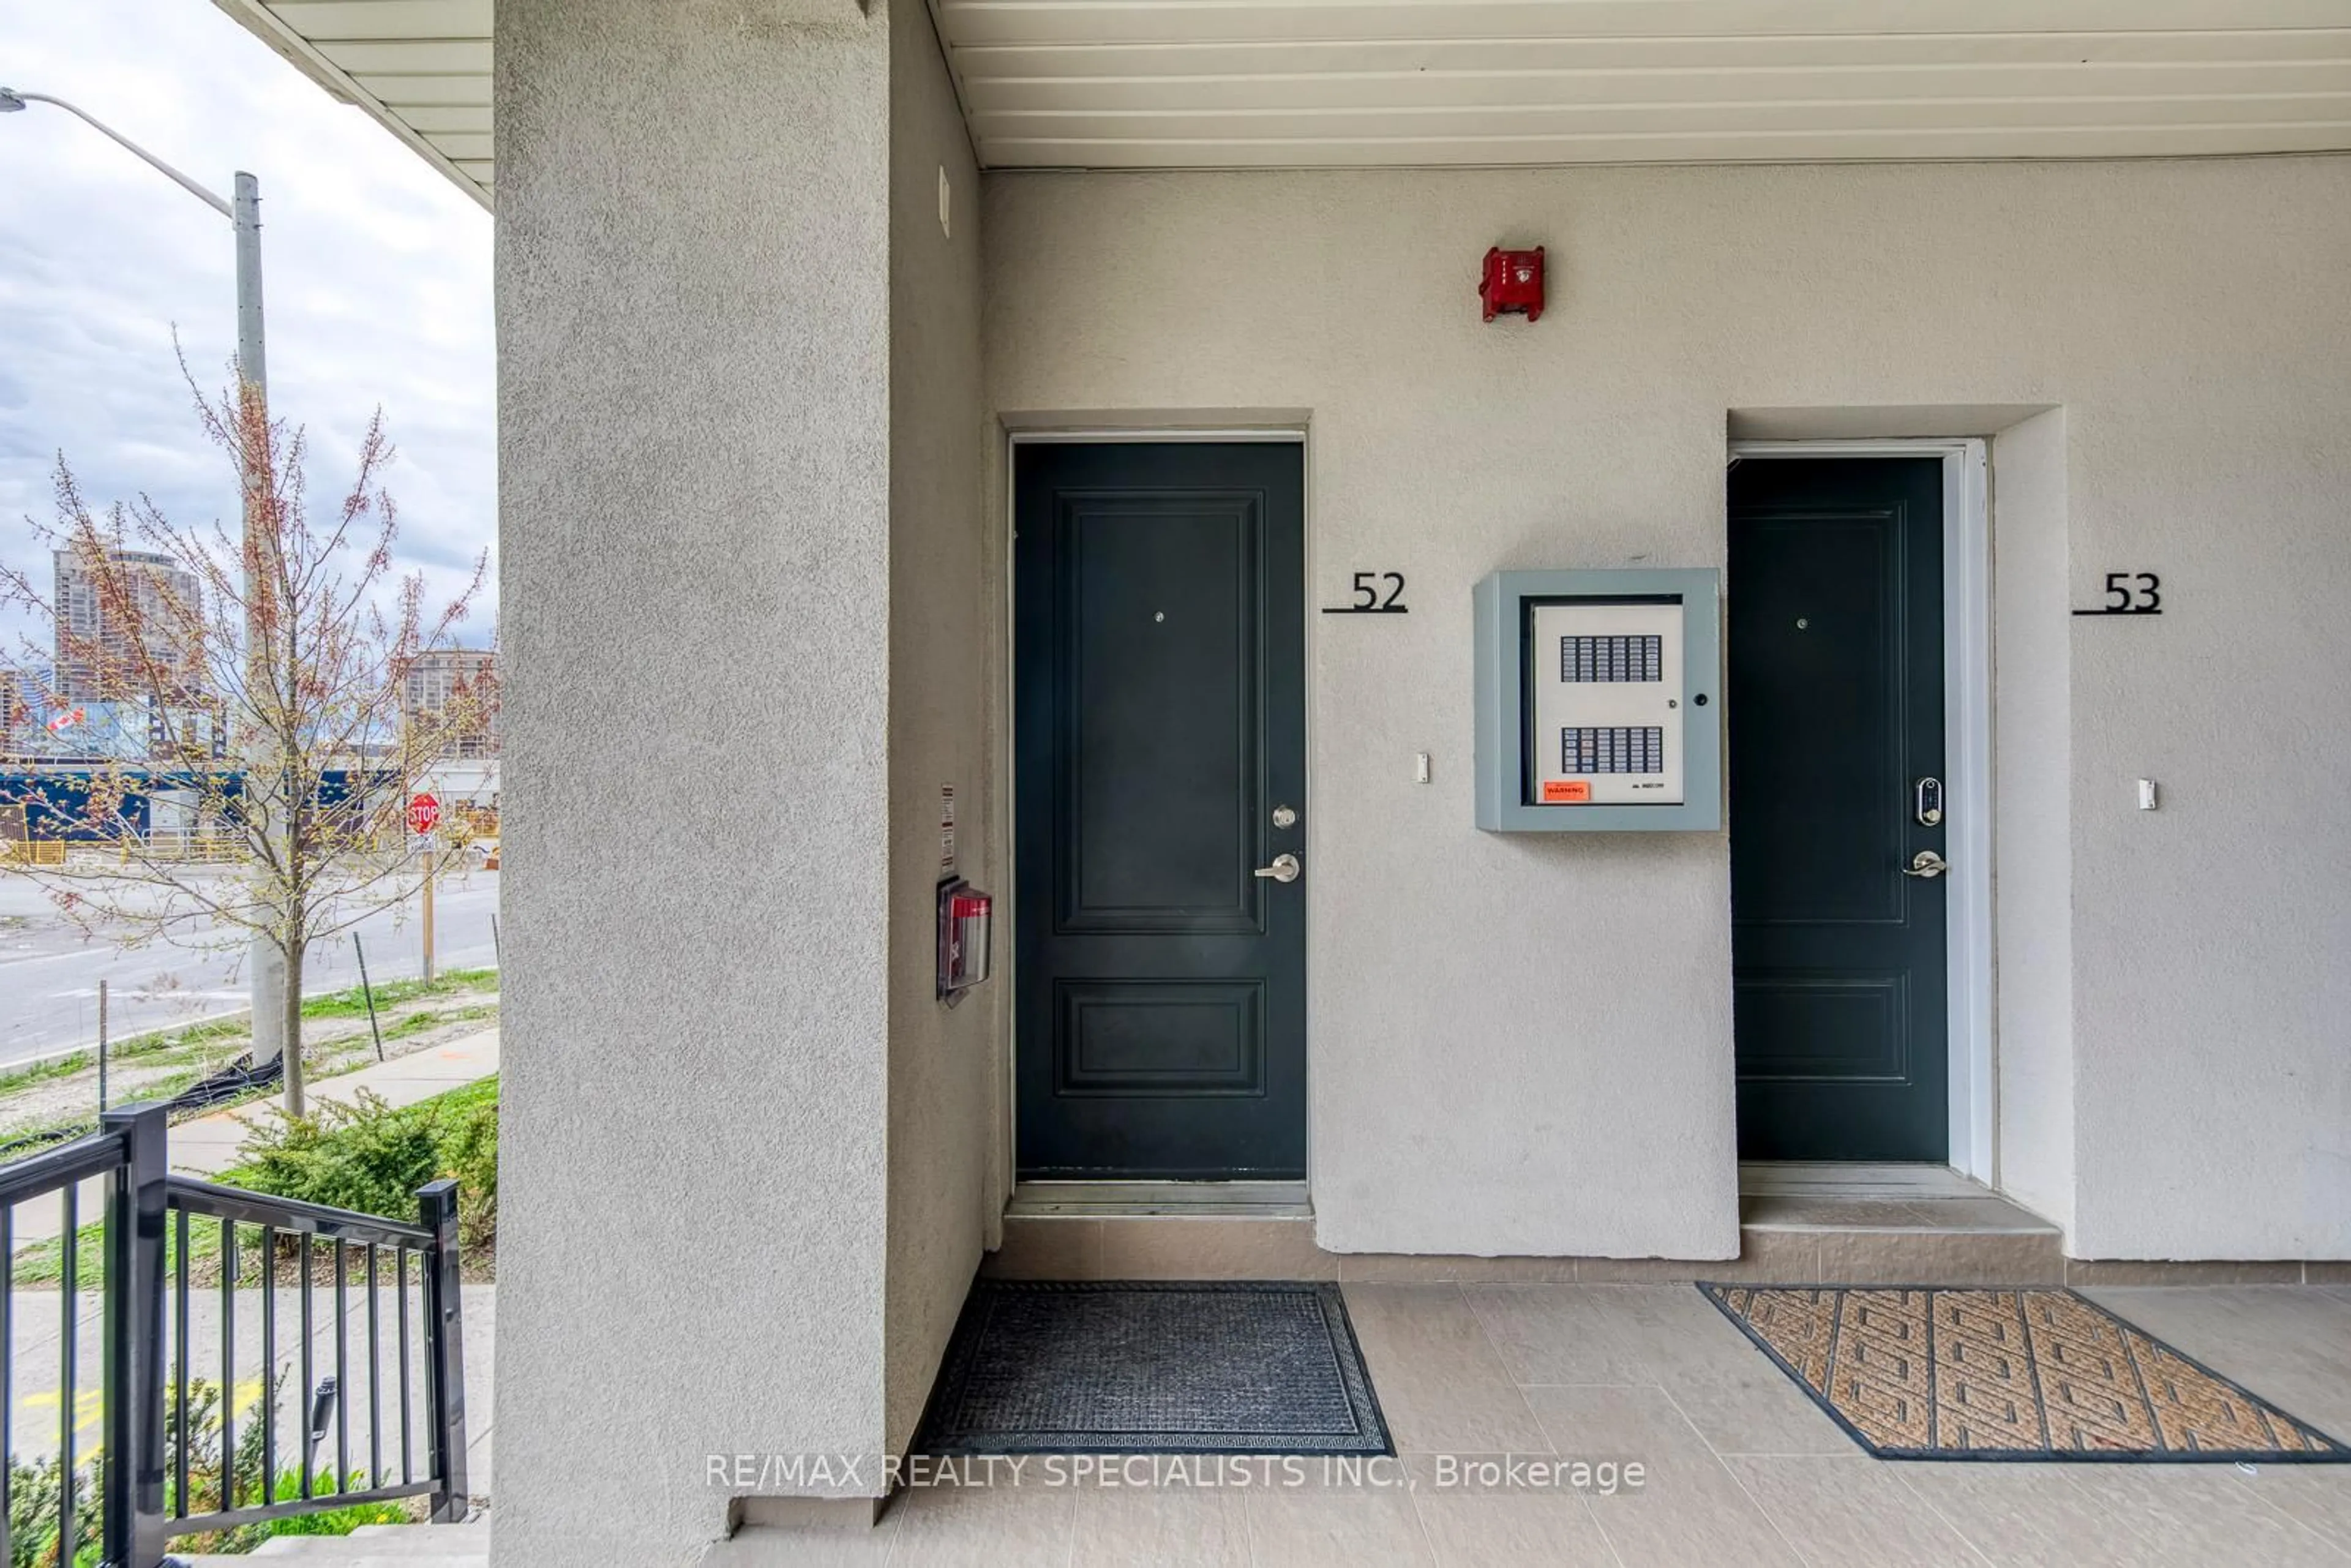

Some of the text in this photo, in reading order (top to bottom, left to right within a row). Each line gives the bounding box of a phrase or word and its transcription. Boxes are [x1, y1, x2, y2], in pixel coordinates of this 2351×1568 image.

[1353, 572, 1406, 613] 52
[2105, 573, 2160, 614] 53
[408, 805, 438, 822] STOP
